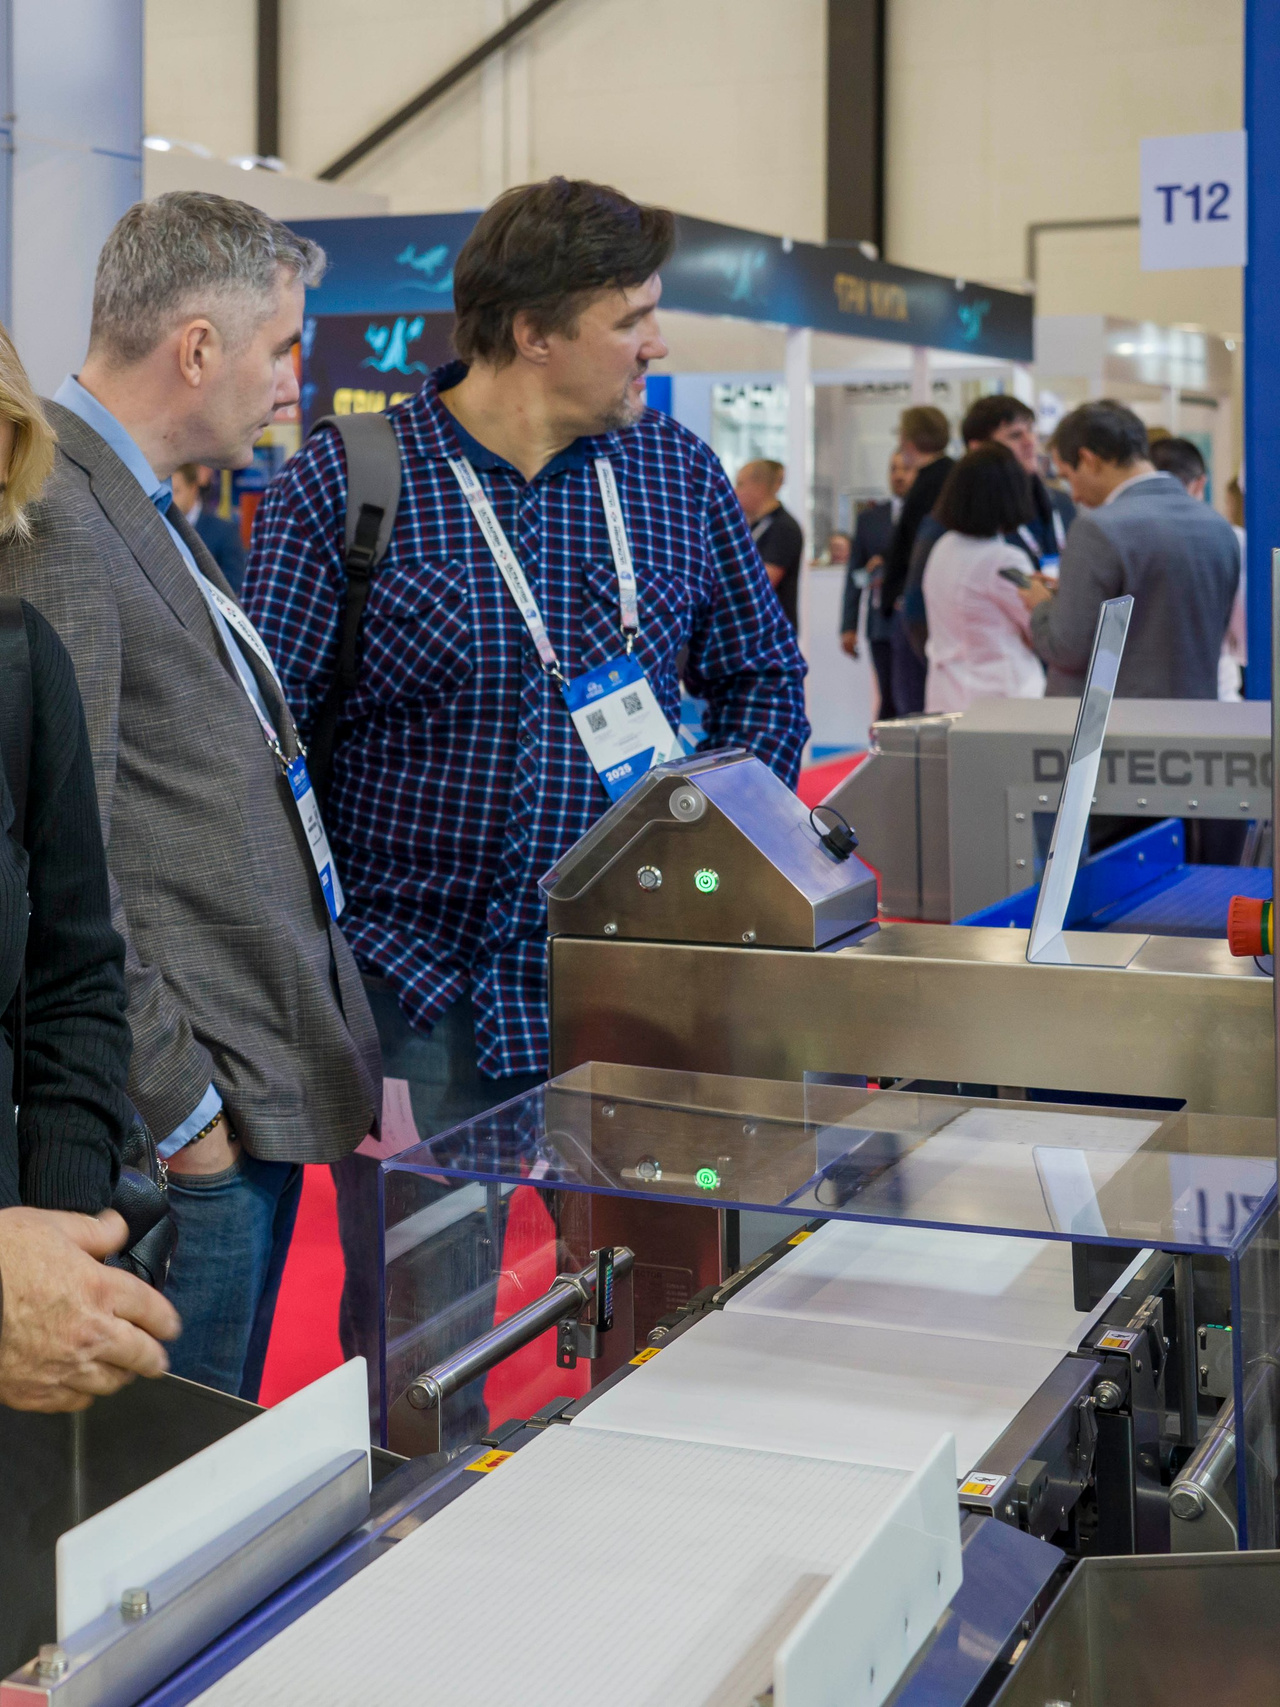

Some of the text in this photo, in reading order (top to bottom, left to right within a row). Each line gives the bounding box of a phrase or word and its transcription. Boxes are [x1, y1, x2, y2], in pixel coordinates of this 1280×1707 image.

[1155, 182, 1230, 224] T12
[606, 762, 632, 782] 2025
[1033, 748, 1272, 787] DTECTR
